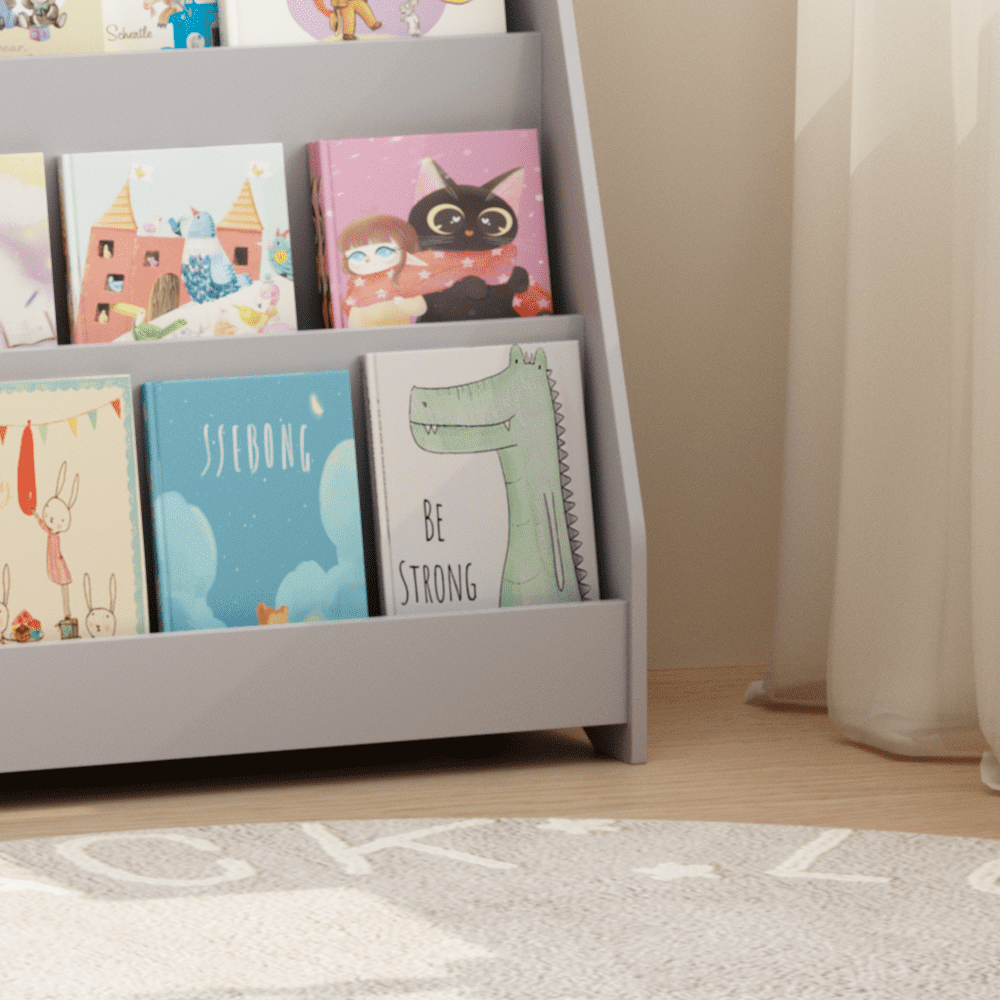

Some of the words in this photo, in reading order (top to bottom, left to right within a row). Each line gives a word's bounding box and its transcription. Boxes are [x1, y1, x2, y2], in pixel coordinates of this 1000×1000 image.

[201, 423, 311, 477] SSEBONG
[423, 498, 446, 542] BE
[399, 560, 477, 606] STRONG
